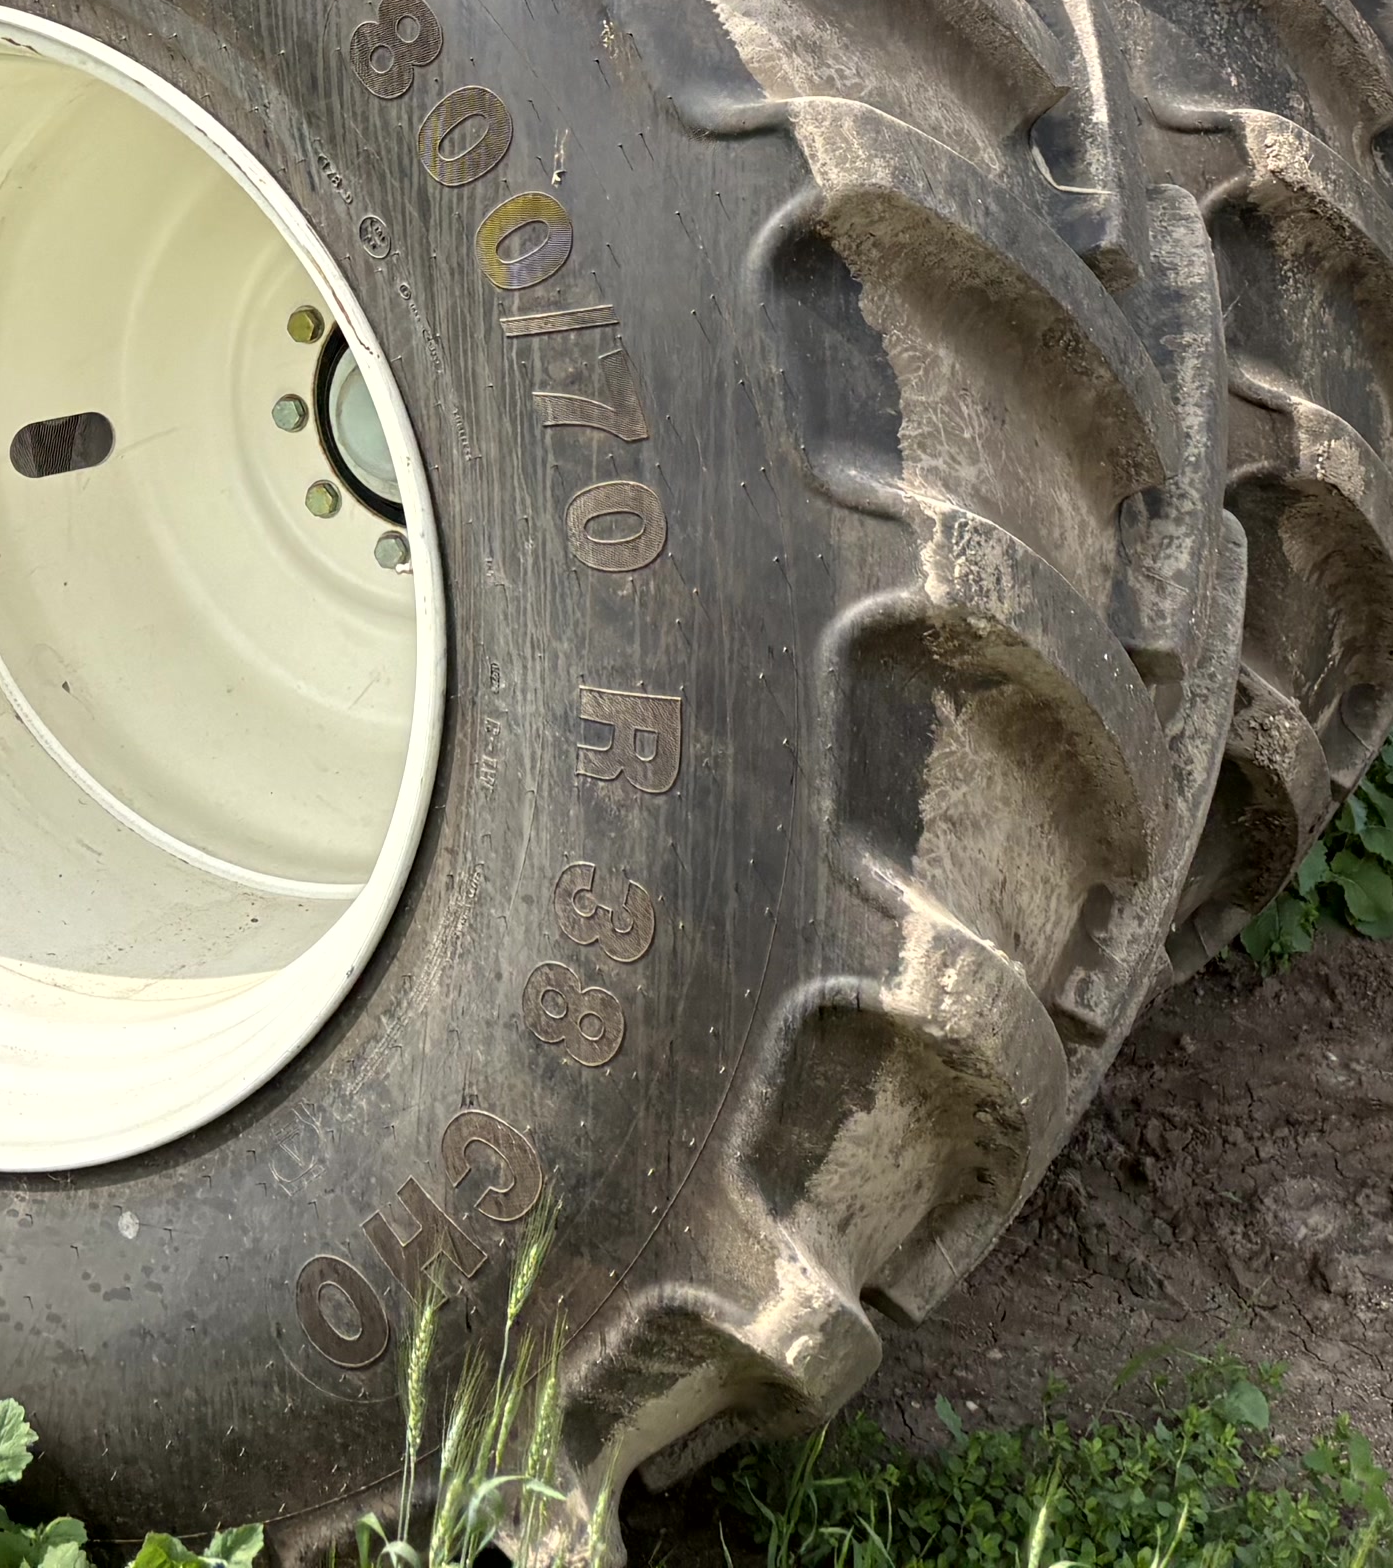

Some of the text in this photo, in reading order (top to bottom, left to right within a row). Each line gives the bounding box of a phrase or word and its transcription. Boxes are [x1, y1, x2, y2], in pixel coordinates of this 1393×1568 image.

[575, 685, 683, 794] R
[521, 860, 656, 1068] 38
[294, 1108, 546, 1369] CHO
